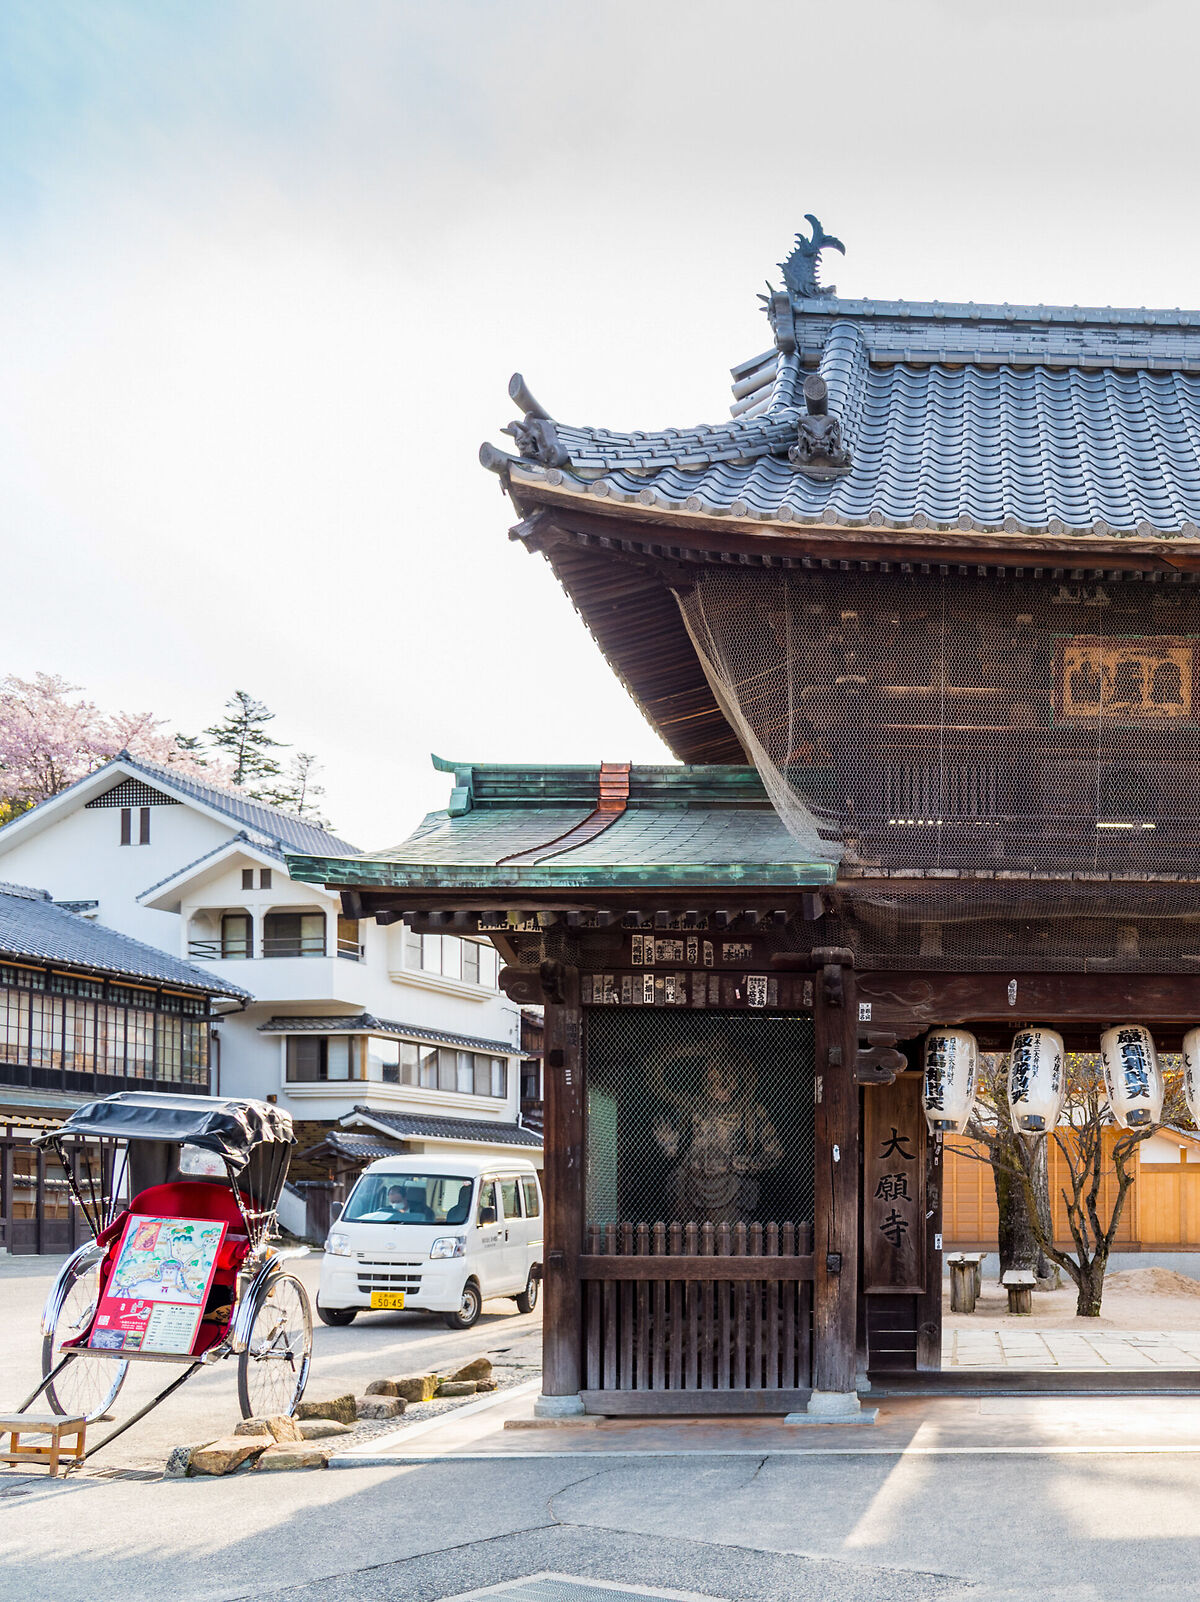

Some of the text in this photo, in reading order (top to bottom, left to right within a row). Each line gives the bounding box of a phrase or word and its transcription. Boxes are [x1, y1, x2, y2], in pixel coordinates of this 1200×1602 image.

[874, 1127, 916, 1248] 大願寺
[378, 1298, 403, 1308] 50-45
